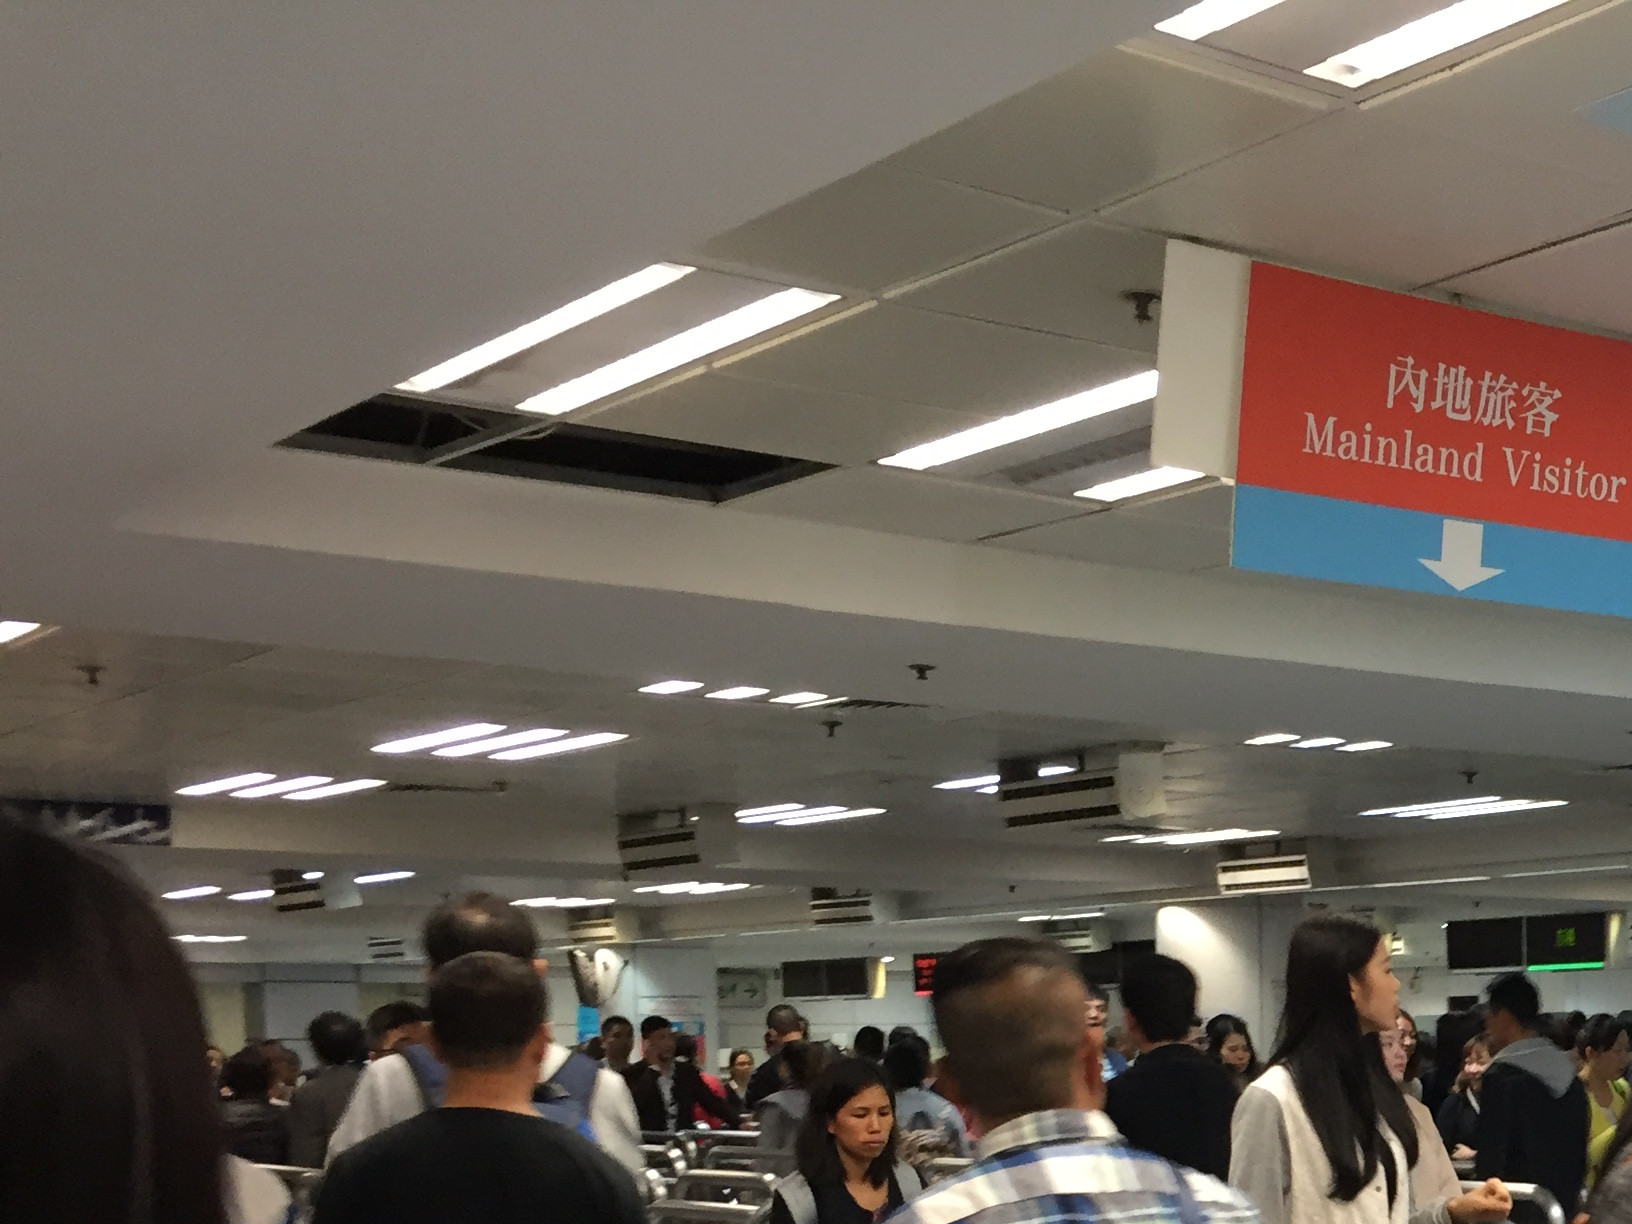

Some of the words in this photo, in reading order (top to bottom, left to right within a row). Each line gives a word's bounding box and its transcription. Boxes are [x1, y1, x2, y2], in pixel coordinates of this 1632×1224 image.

[1386, 355, 1563, 438] 內地旅客
[1302, 411, 1484, 482] Mainland
[1502, 445, 1627, 503] Visitor
